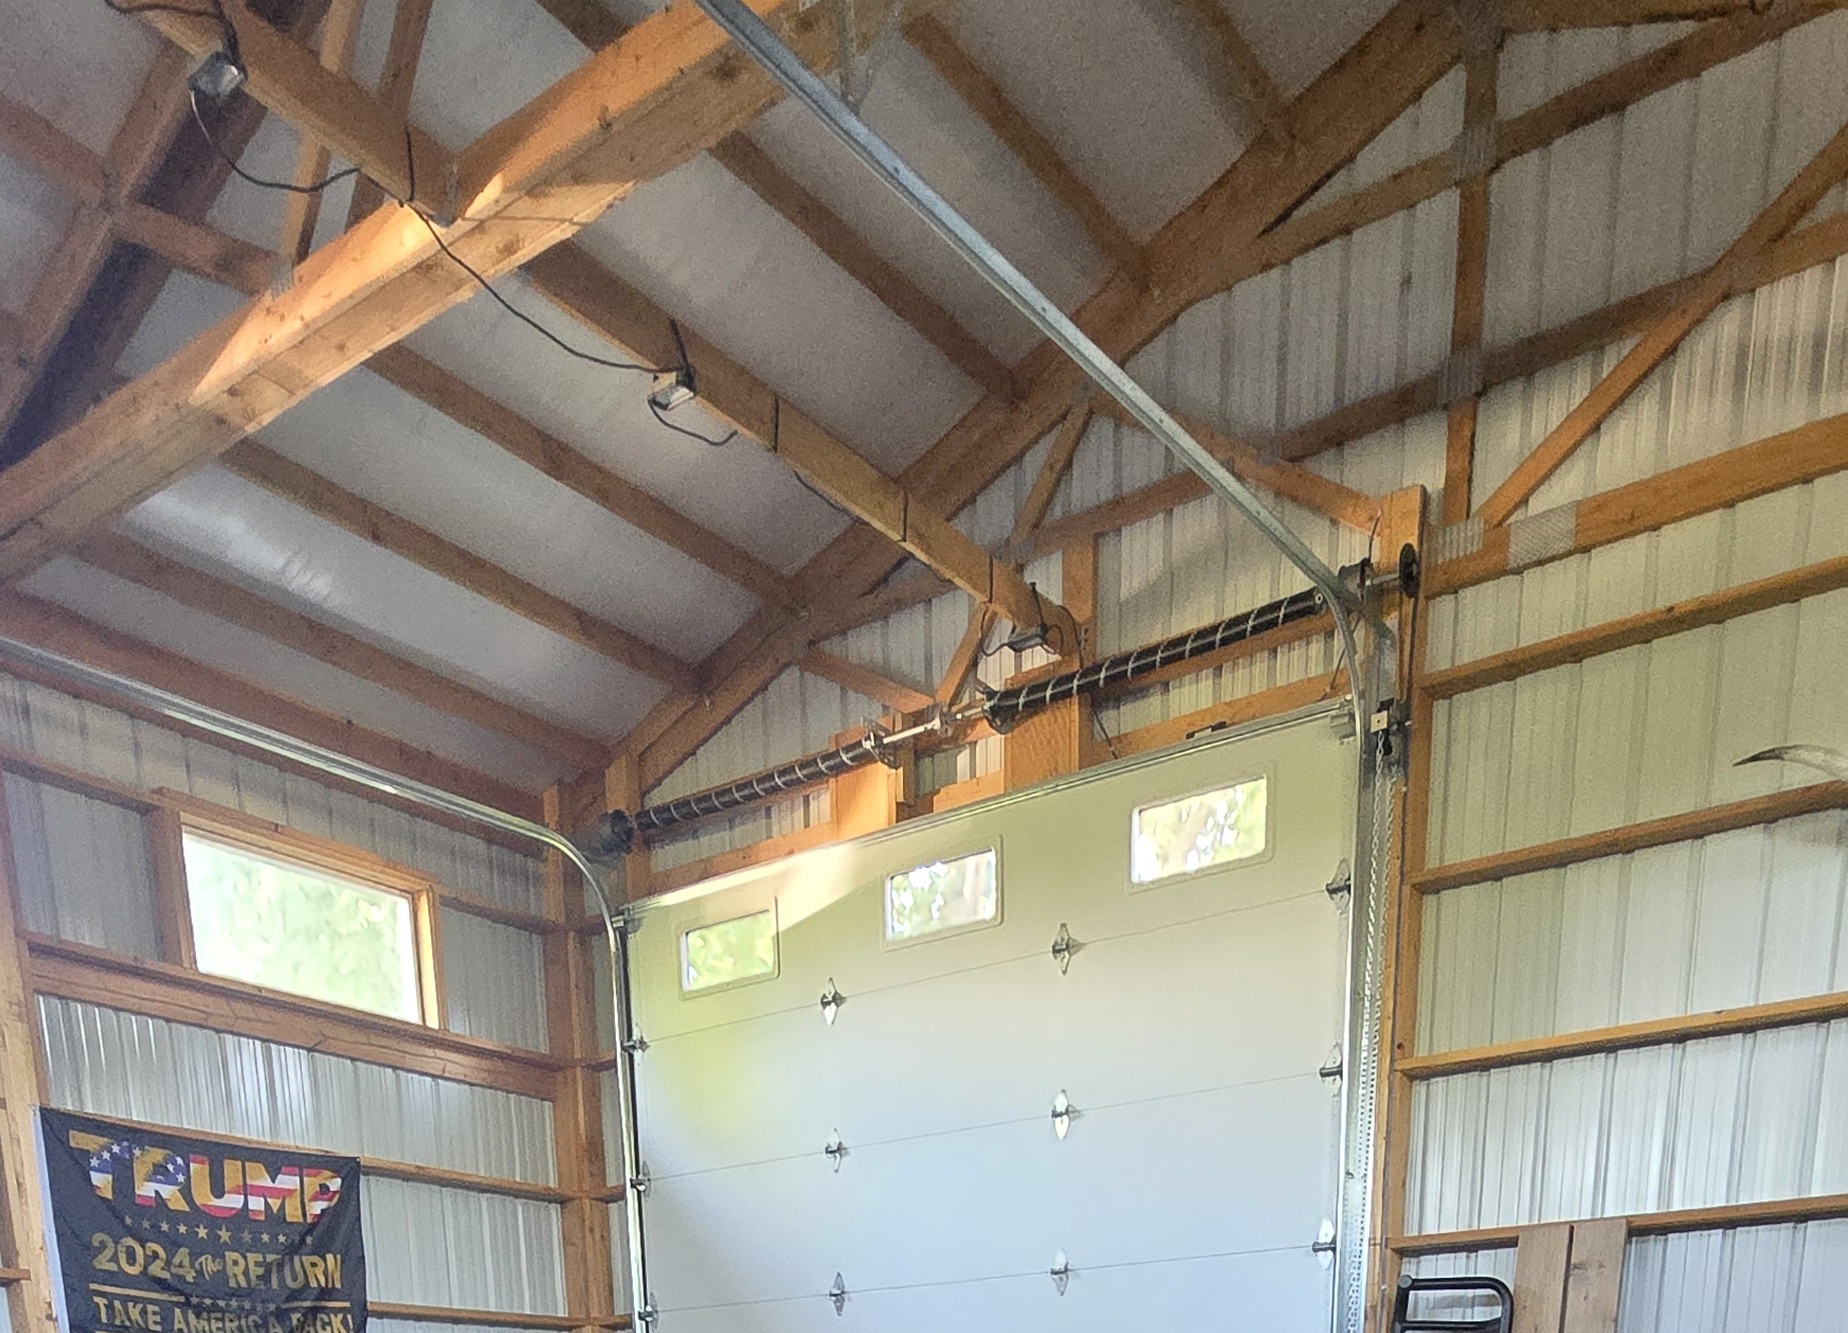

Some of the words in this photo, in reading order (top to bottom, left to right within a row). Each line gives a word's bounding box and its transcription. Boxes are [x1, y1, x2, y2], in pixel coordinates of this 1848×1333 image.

[69, 1130, 342, 1223] TRUMP
[91, 1232, 196, 1282] 2024
[224, 1252, 342, 1290] RETURN
[92, 1295, 162, 1332] TAKE
